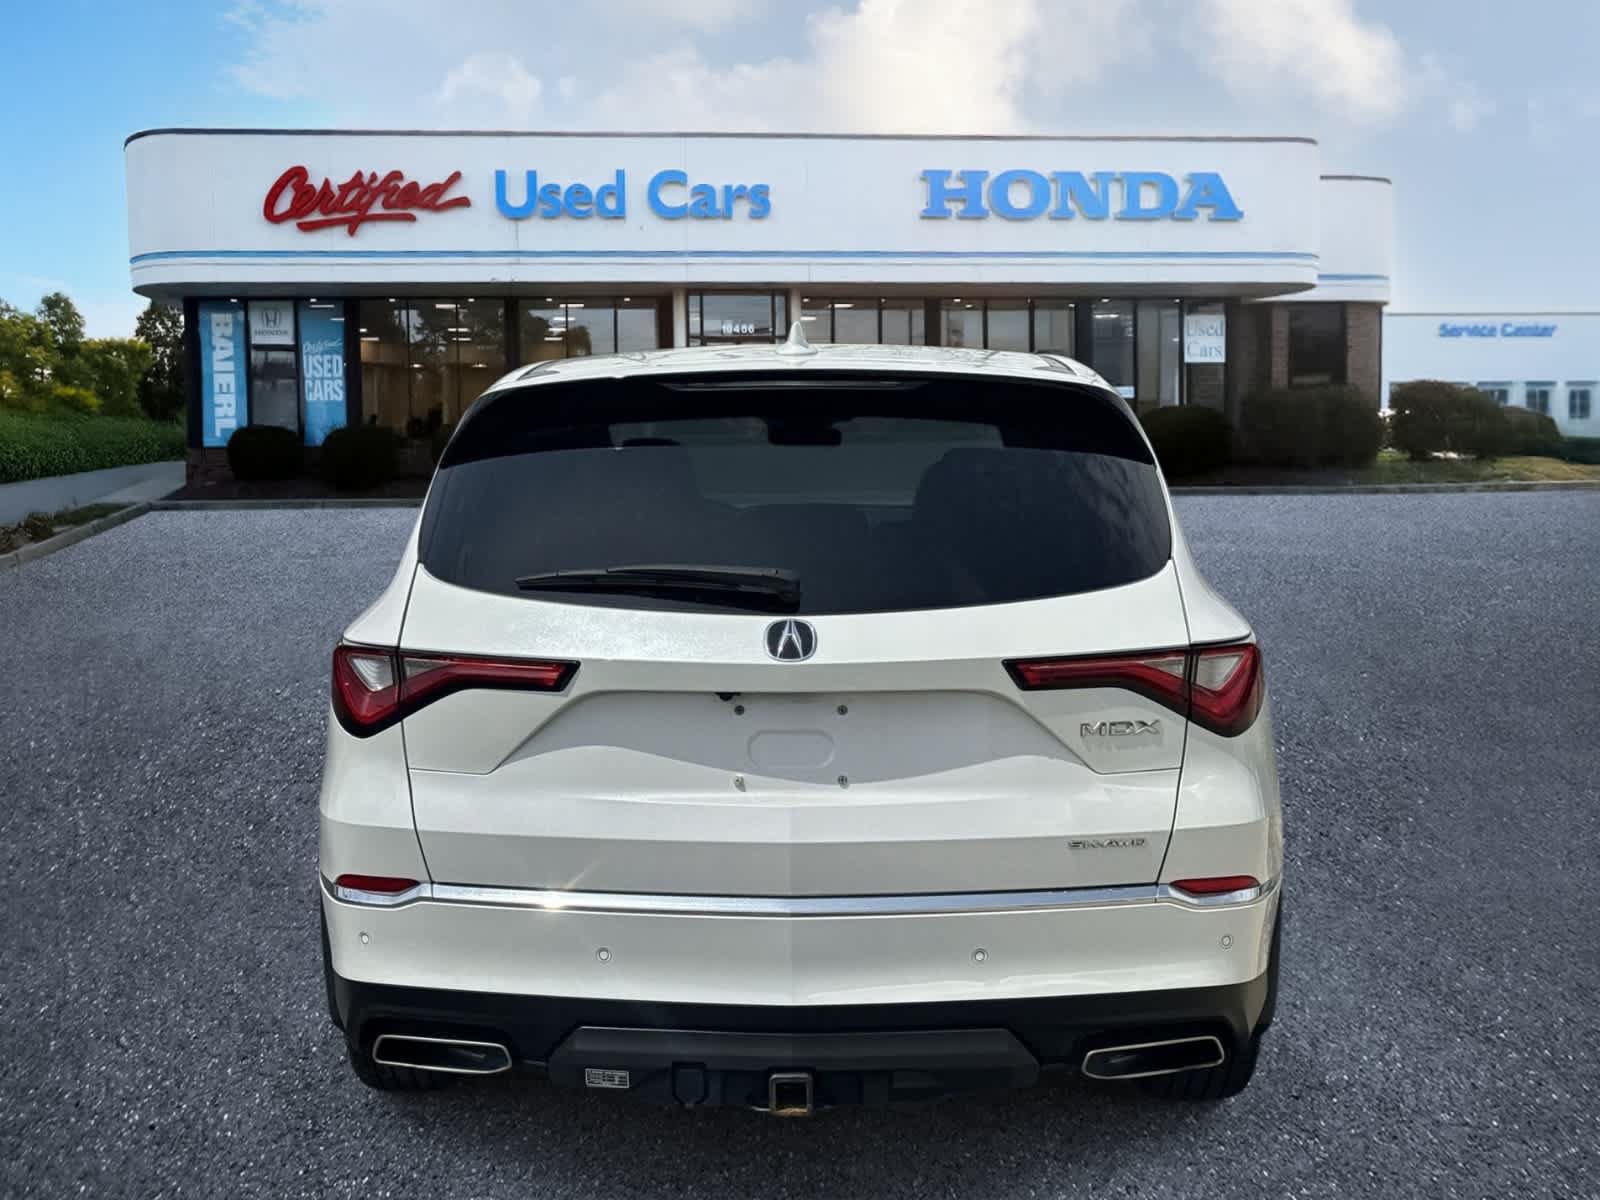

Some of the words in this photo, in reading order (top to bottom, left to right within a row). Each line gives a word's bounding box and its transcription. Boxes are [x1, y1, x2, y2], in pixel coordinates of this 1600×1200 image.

[264, 165, 471, 236] Certified
[495, 169, 625, 219] Used
[648, 169, 771, 219] Cars
[920, 169, 1244, 221] HONDA
[1186, 319, 1225, 337] Used
[1186, 341, 1224, 358] Cars
[211, 312, 236, 437] BAIERL
[303, 355, 343, 378] USED
[305, 379, 344, 401] CARS
[1080, 720, 1161, 737] MDX
